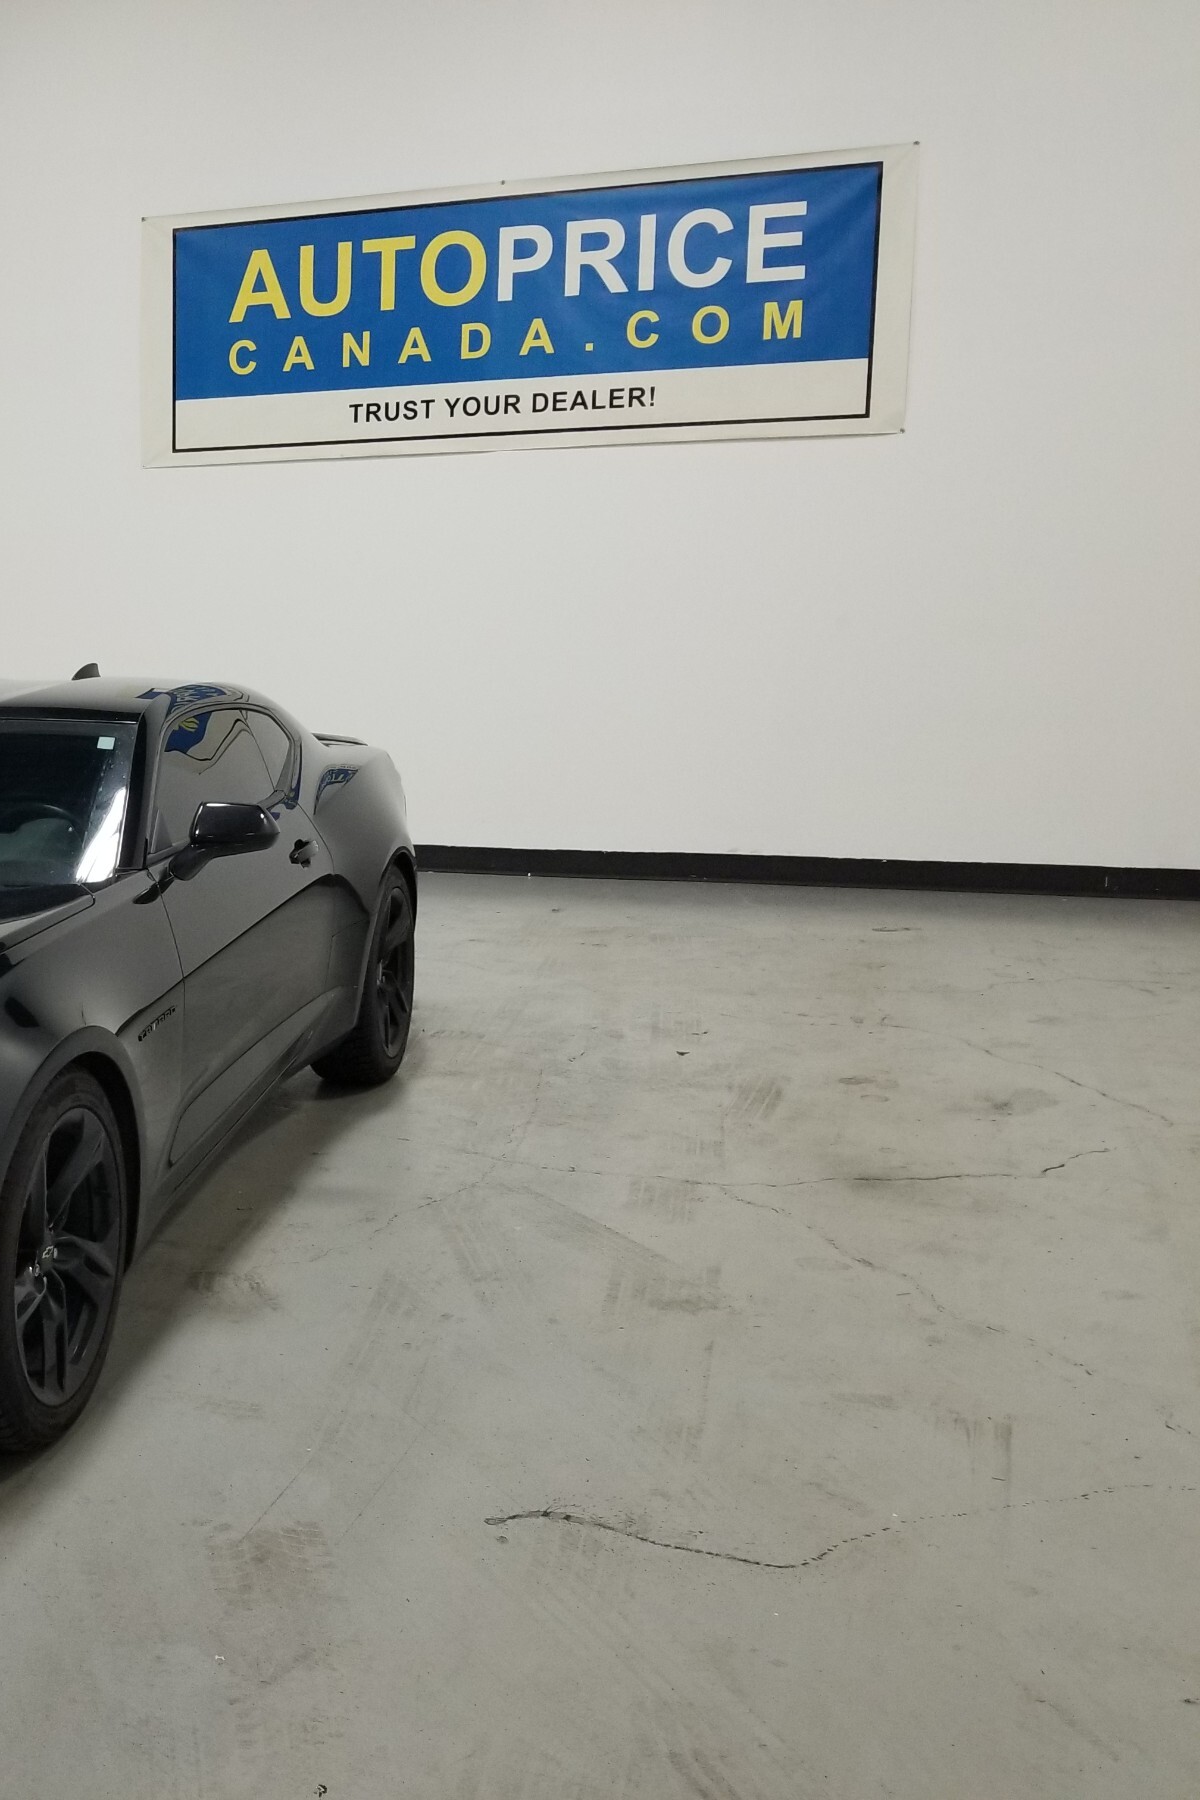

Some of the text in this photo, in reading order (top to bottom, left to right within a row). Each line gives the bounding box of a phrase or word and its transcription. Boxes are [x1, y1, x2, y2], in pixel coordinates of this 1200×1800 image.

[228, 201, 807, 323] AUTOPRICE
[228, 300, 803, 375] CANADA.COM
[349, 386, 656, 423] TRUST YOUR DEALER!
